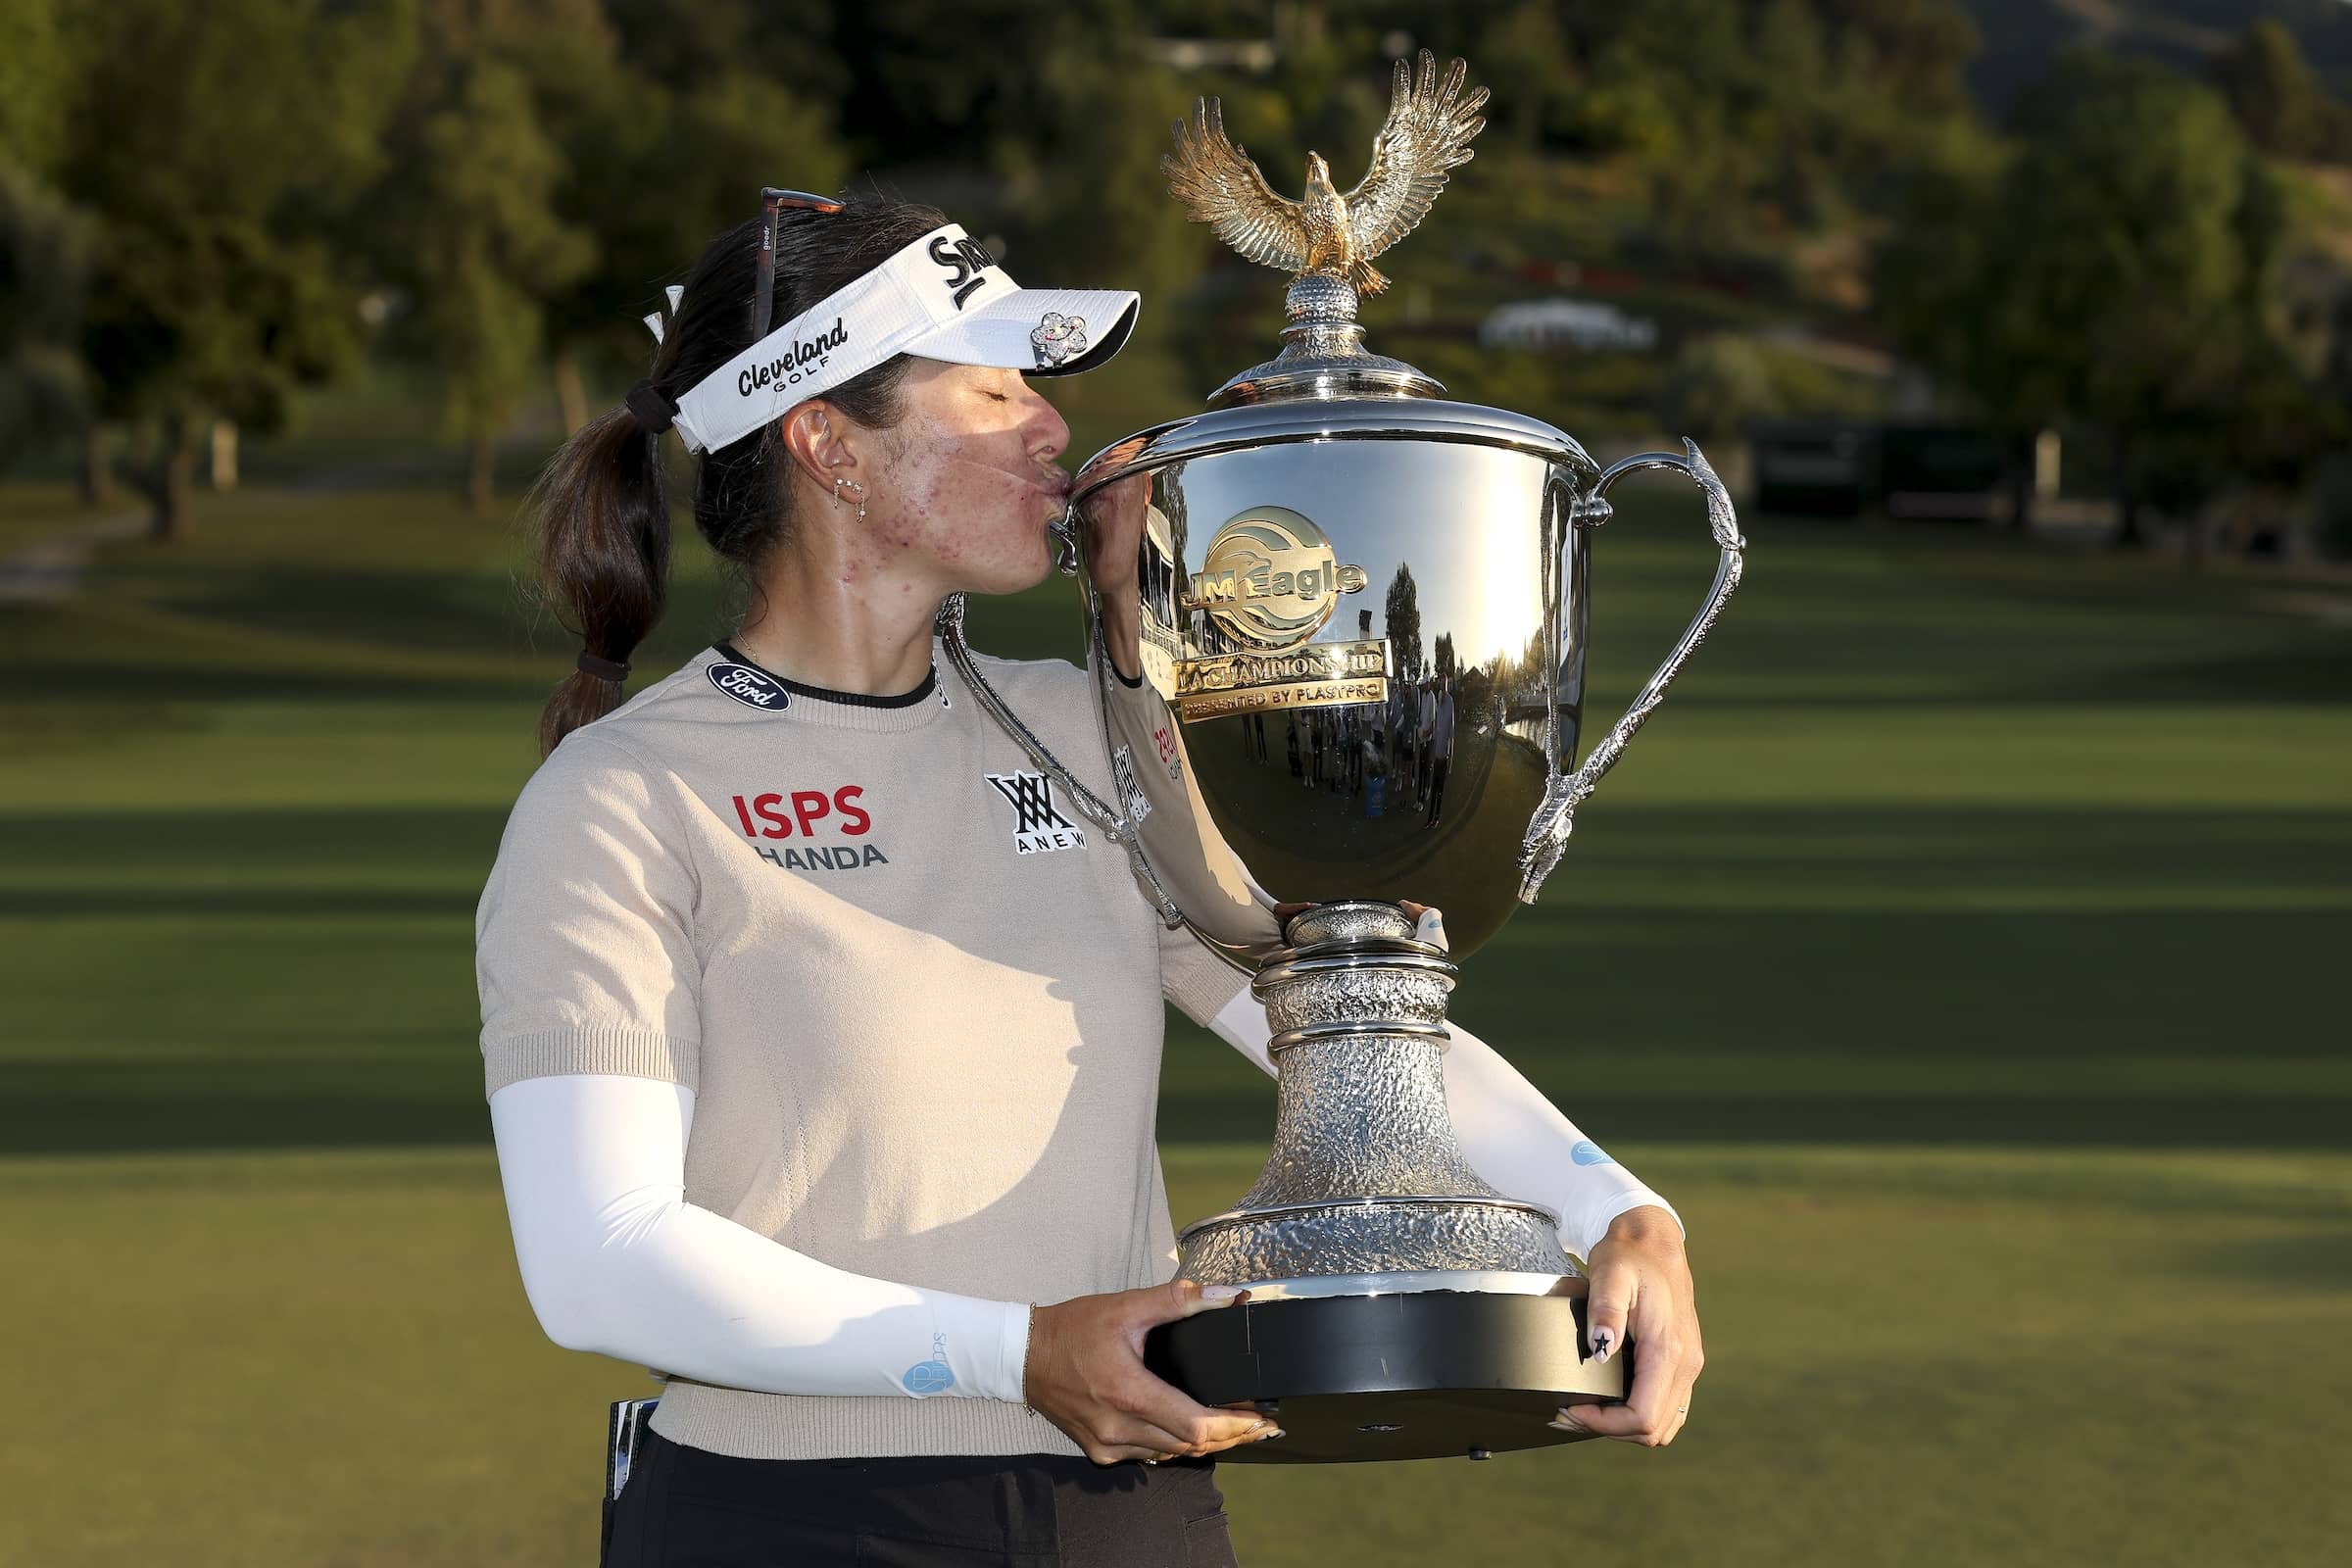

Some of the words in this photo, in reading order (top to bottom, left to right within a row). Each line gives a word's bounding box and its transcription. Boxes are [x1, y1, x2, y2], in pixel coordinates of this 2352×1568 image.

[738, 317, 848, 397] Cleveland
[773, 356, 829, 392] GOLF
[1182, 569, 1238, 606] JM
[1245, 560, 1366, 601] Eagle
[1206, 653, 1383, 685] CHAMPIONSHIP
[720, 668, 777, 707] Ford
[1273, 690, 1290, 704] BY
[1297, 684, 1381, 702] PLASTPRO
[732, 785, 871, 839] ISPS
[754, 844, 889, 870] HANDA
[1018, 832, 1086, 853] ANEW
